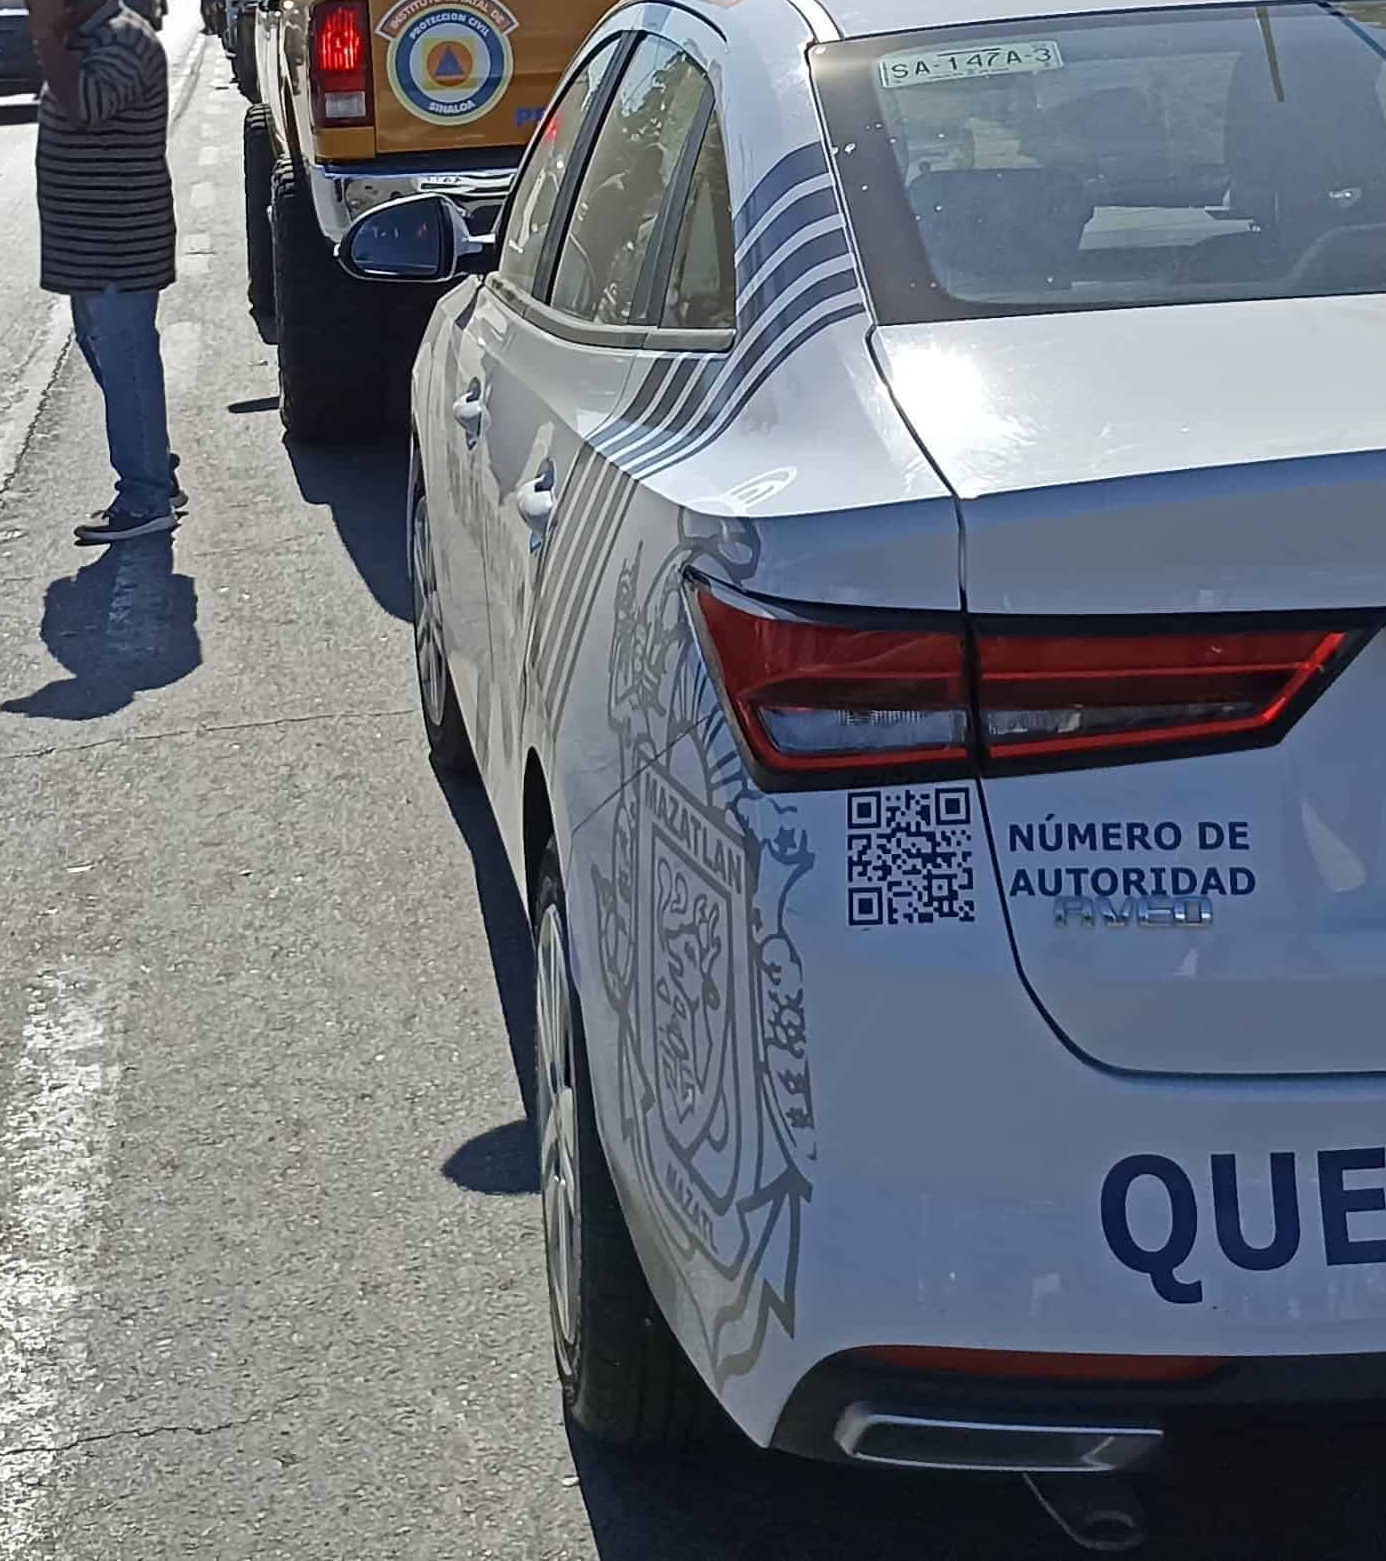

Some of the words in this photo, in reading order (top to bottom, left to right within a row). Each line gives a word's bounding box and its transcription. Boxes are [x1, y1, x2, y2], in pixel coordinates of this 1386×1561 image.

[468, 15, 490, 36] CIVIL
[490, 10, 505, 24] DE
[891, 47, 1052, 80] SA-147A-3
[428, 100, 476, 114] SINALOA
[1010, 813, 1183, 852] NÚMERO
[1198, 821, 1250, 851] DE
[1009, 866, 1256, 898] AUTORIDAD
